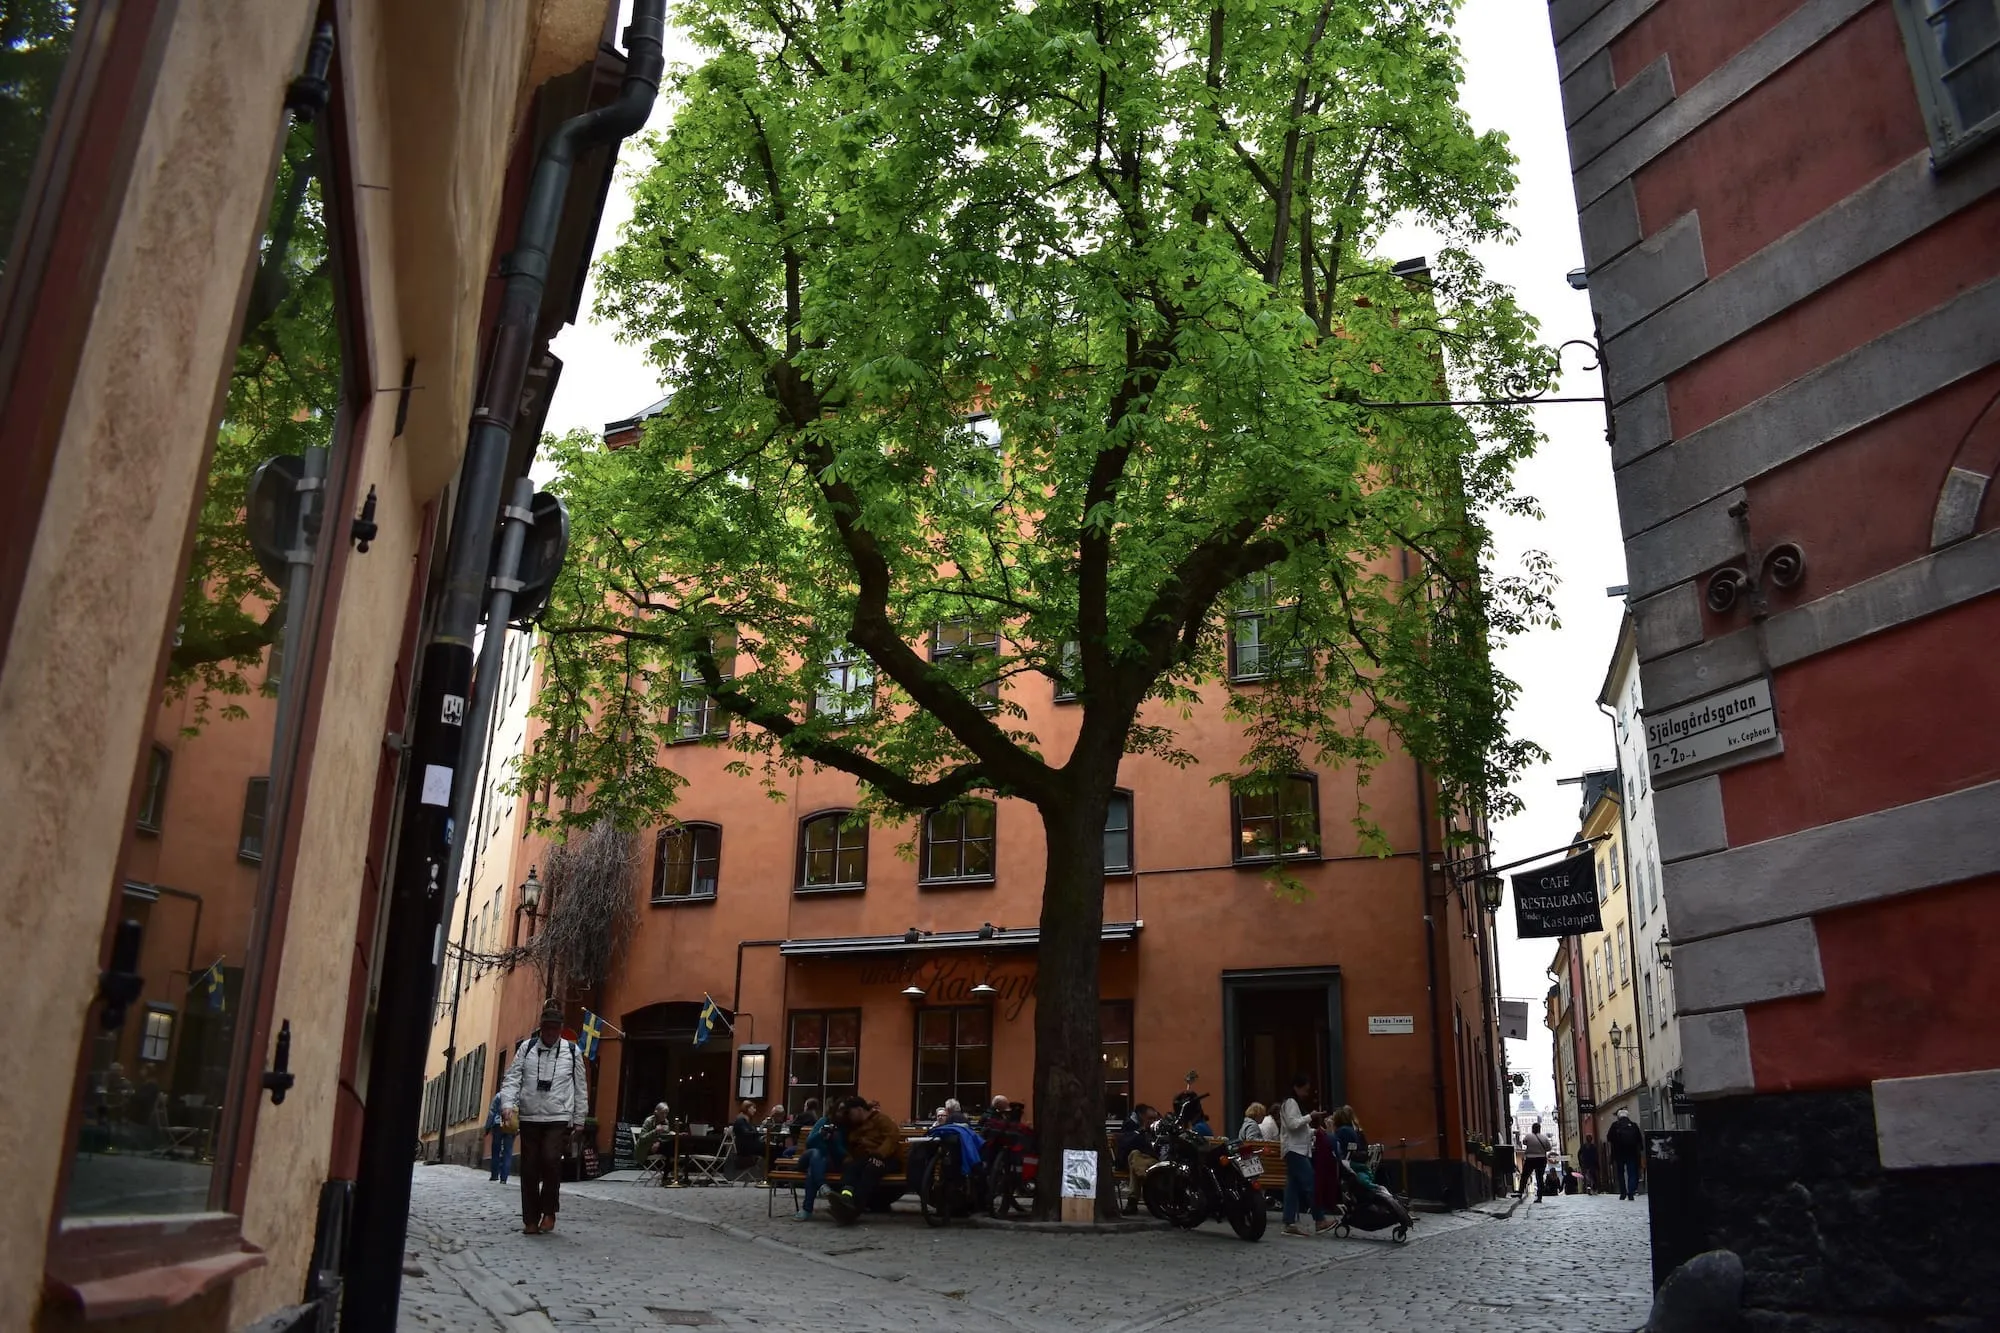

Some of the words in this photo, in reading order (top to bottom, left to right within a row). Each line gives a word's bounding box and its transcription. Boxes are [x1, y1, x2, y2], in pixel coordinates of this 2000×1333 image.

[1649, 695, 1756, 744] Själagårdsgatan
[1727, 735, 1740, 746] kv.
[1521, 891, 1593, 909] RESTAURANG
[1542, 913, 1595, 928] Kastanjen
